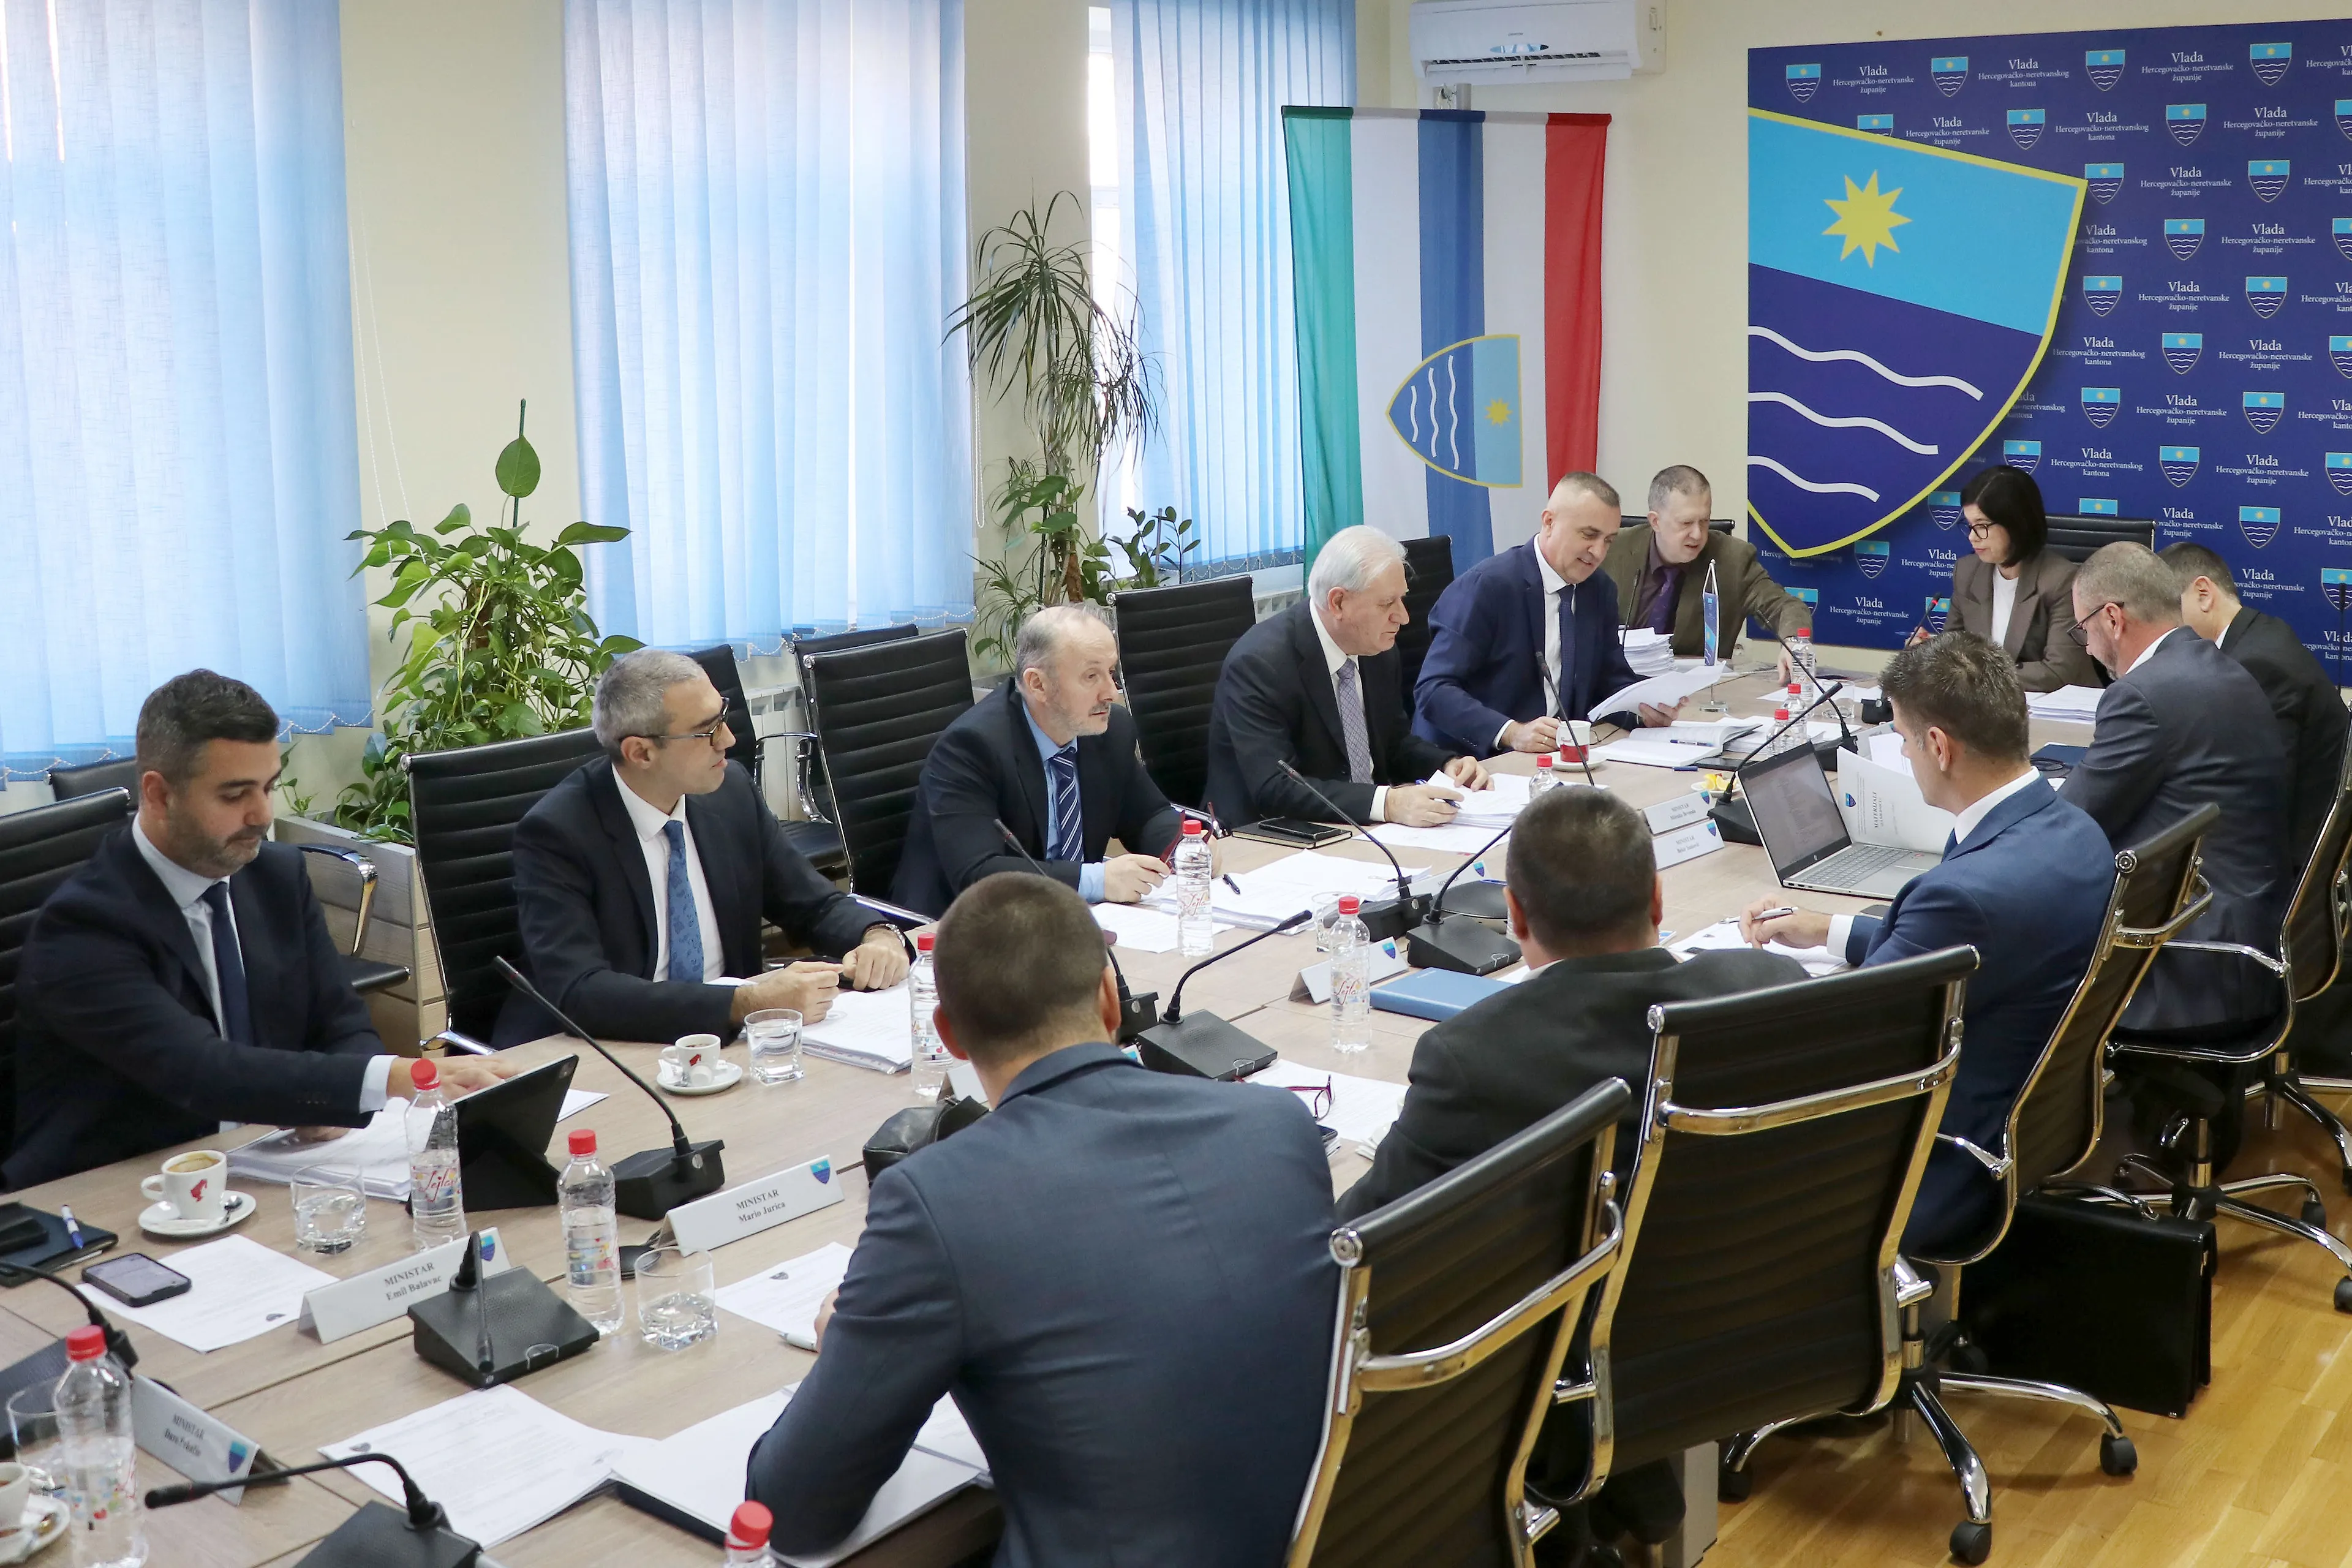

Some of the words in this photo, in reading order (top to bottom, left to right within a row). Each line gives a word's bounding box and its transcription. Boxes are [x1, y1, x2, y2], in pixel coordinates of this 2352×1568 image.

[2171, 51, 2204, 62] Vlada
[2008, 58, 2039, 69] Vlada
[2141, 63, 2234, 75] Hercegovačko-neretvanske
[1859, 65, 1888, 76] Vlada
[1978, 70, 2070, 81] Hercegovačko-neretvanskog
[1833, 76, 1915, 87] Hercegovačko-neretvanske
[2172, 74, 2202, 83] županije
[1860, 86, 1887, 96] županije
[2086, 111, 2117, 123] Vlada
[2254, 107, 2288, 118] Vlada
[1932, 116, 1962, 127] Vlada
[2223, 119, 2318, 130] Hercegovačko-neretvanske
[1905, 127, 1990, 138] Hercegovačko-neretvanske
[2056, 123, 2149, 134] Hercegovačko-neretvanskog
[2254, 129, 2286, 139] županije
[1934, 138, 1961, 146] županije
[2169, 167, 2202, 178] Vlada
[2140, 179, 2233, 189] Hercegovačko-neretvanske
[2171, 189, 2201, 198] županije
[2086, 225, 2116, 235] Vlada
[2252, 224, 2285, 235] Vlada
[2221, 236, 2316, 246] Hercegovačko-neretvanske
[2252, 246, 2283, 255] županije
[2168, 281, 2200, 292] Vlada
[2138, 294, 2230, 303] Hercegovačko-neretvanske
[2168, 303, 2198, 312] županije
[2082, 337, 2114, 348] Vlada
[2248, 339, 2282, 351] Vlada
[2053, 349, 2146, 360] Hercegovačko-neretvanskog
[2218, 352, 2313, 361] Hercegovačko-neretvanske
[2249, 361, 2281, 371] županije
[2165, 394, 2198, 405] Vlada
[2136, 407, 2228, 417] Hercegovačko-neretvanske
[2166, 416, 2196, 426] županije
[2081, 448, 2113, 459] Vlada
[2051, 459, 2144, 471] Hercegovačko-neretvanskog
[2245, 454, 2279, 466] Vlada
[2082, 469, 2110, 477] kantona
[2215, 466, 2309, 477] Hercegovačko-neretvanske
[2246, 477, 2277, 487] županije
[2162, 507, 2195, 519] Vlada
[2163, 529, 2193, 538] županije
[1928, 549, 1957, 560] Vlada
[2241, 568, 2275, 581] Vlada
[2242, 590, 2273, 600] županije
[1855, 597, 1883, 608] Vlada
[1830, 606, 1909, 619] Hercegovačko-neretvanske
[1856, 616, 1882, 626] županije
[736, 1189, 779, 1210] MINISTAR
[739, 1210, 761, 1223] Mario
[763, 1201, 786, 1215] Jurica
[384, 1262, 435, 1286] MINISTAR
[386, 1286, 407, 1300] Emil
[408, 1275, 442, 1292] Balavac
